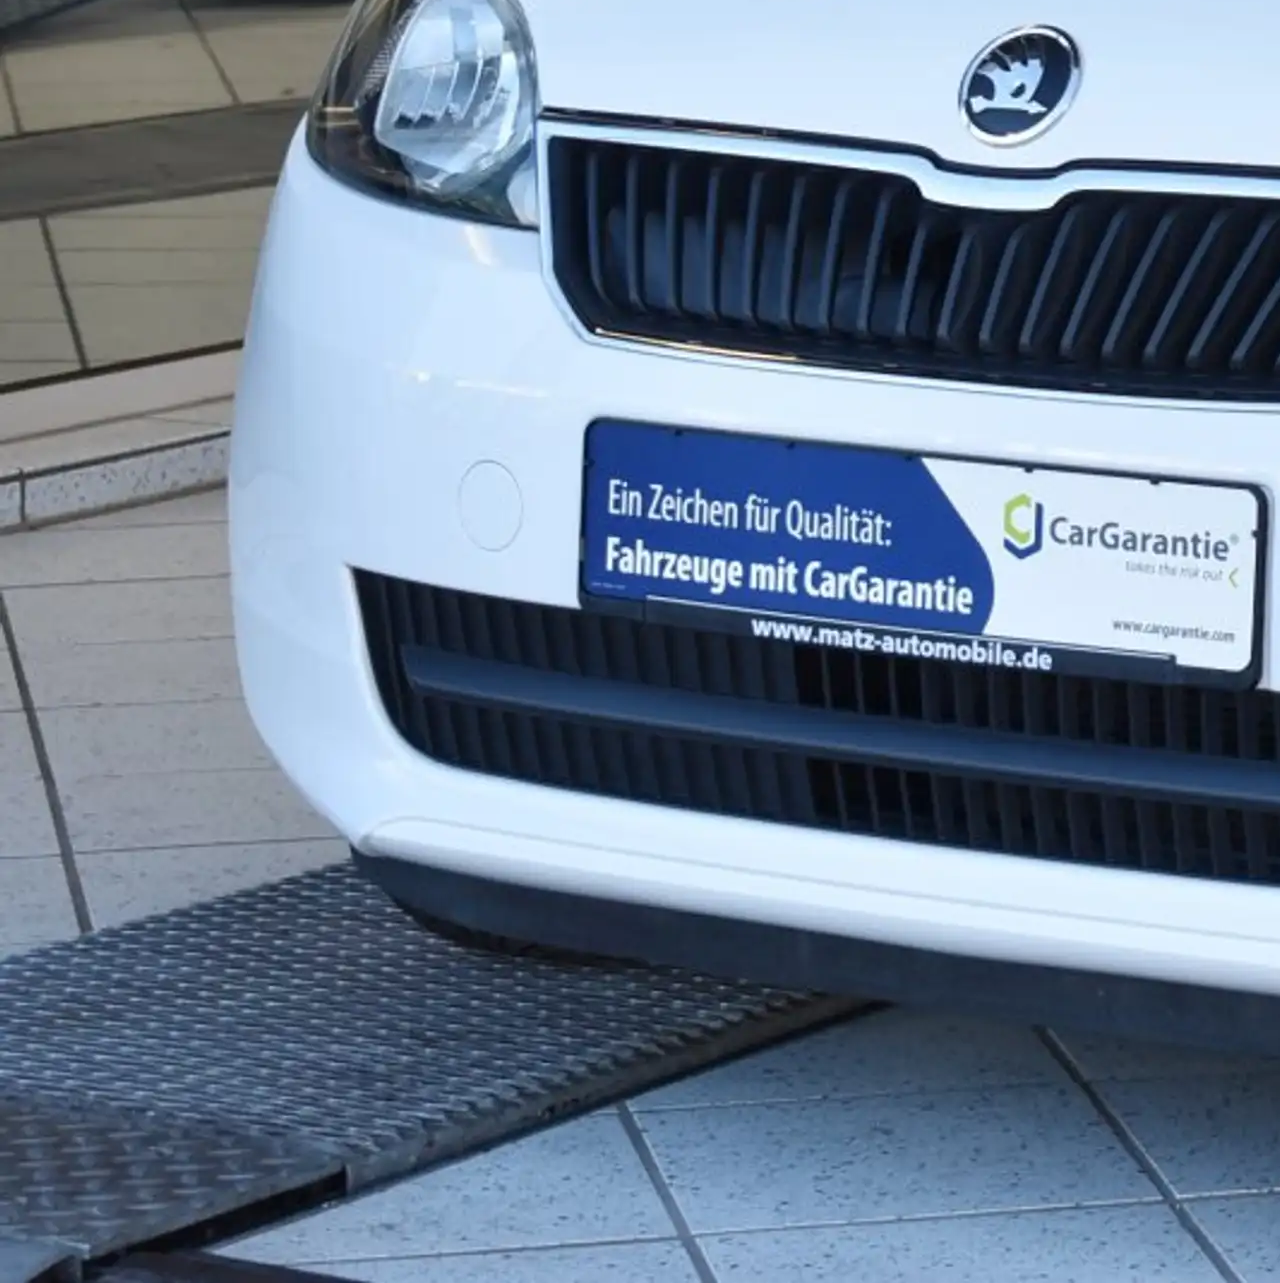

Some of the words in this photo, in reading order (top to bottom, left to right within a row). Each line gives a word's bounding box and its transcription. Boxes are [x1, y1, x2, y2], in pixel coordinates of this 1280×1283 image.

[607, 478, 642, 517] Ein
[648, 483, 738, 529] Zeichen
[745, 493, 781, 534] für
[786, 499, 893, 547] Qualität:
[1050, 516, 1230, 562] CarGarantie
[606, 536, 744, 595] Fahrzeuge
[750, 556, 798, 595] mit
[804, 560, 974, 615] CarGarantie
[751, 618, 1053, 670] www.matz-automobile.de
[1113, 619, 1235, 643] www.cargarantie.com
